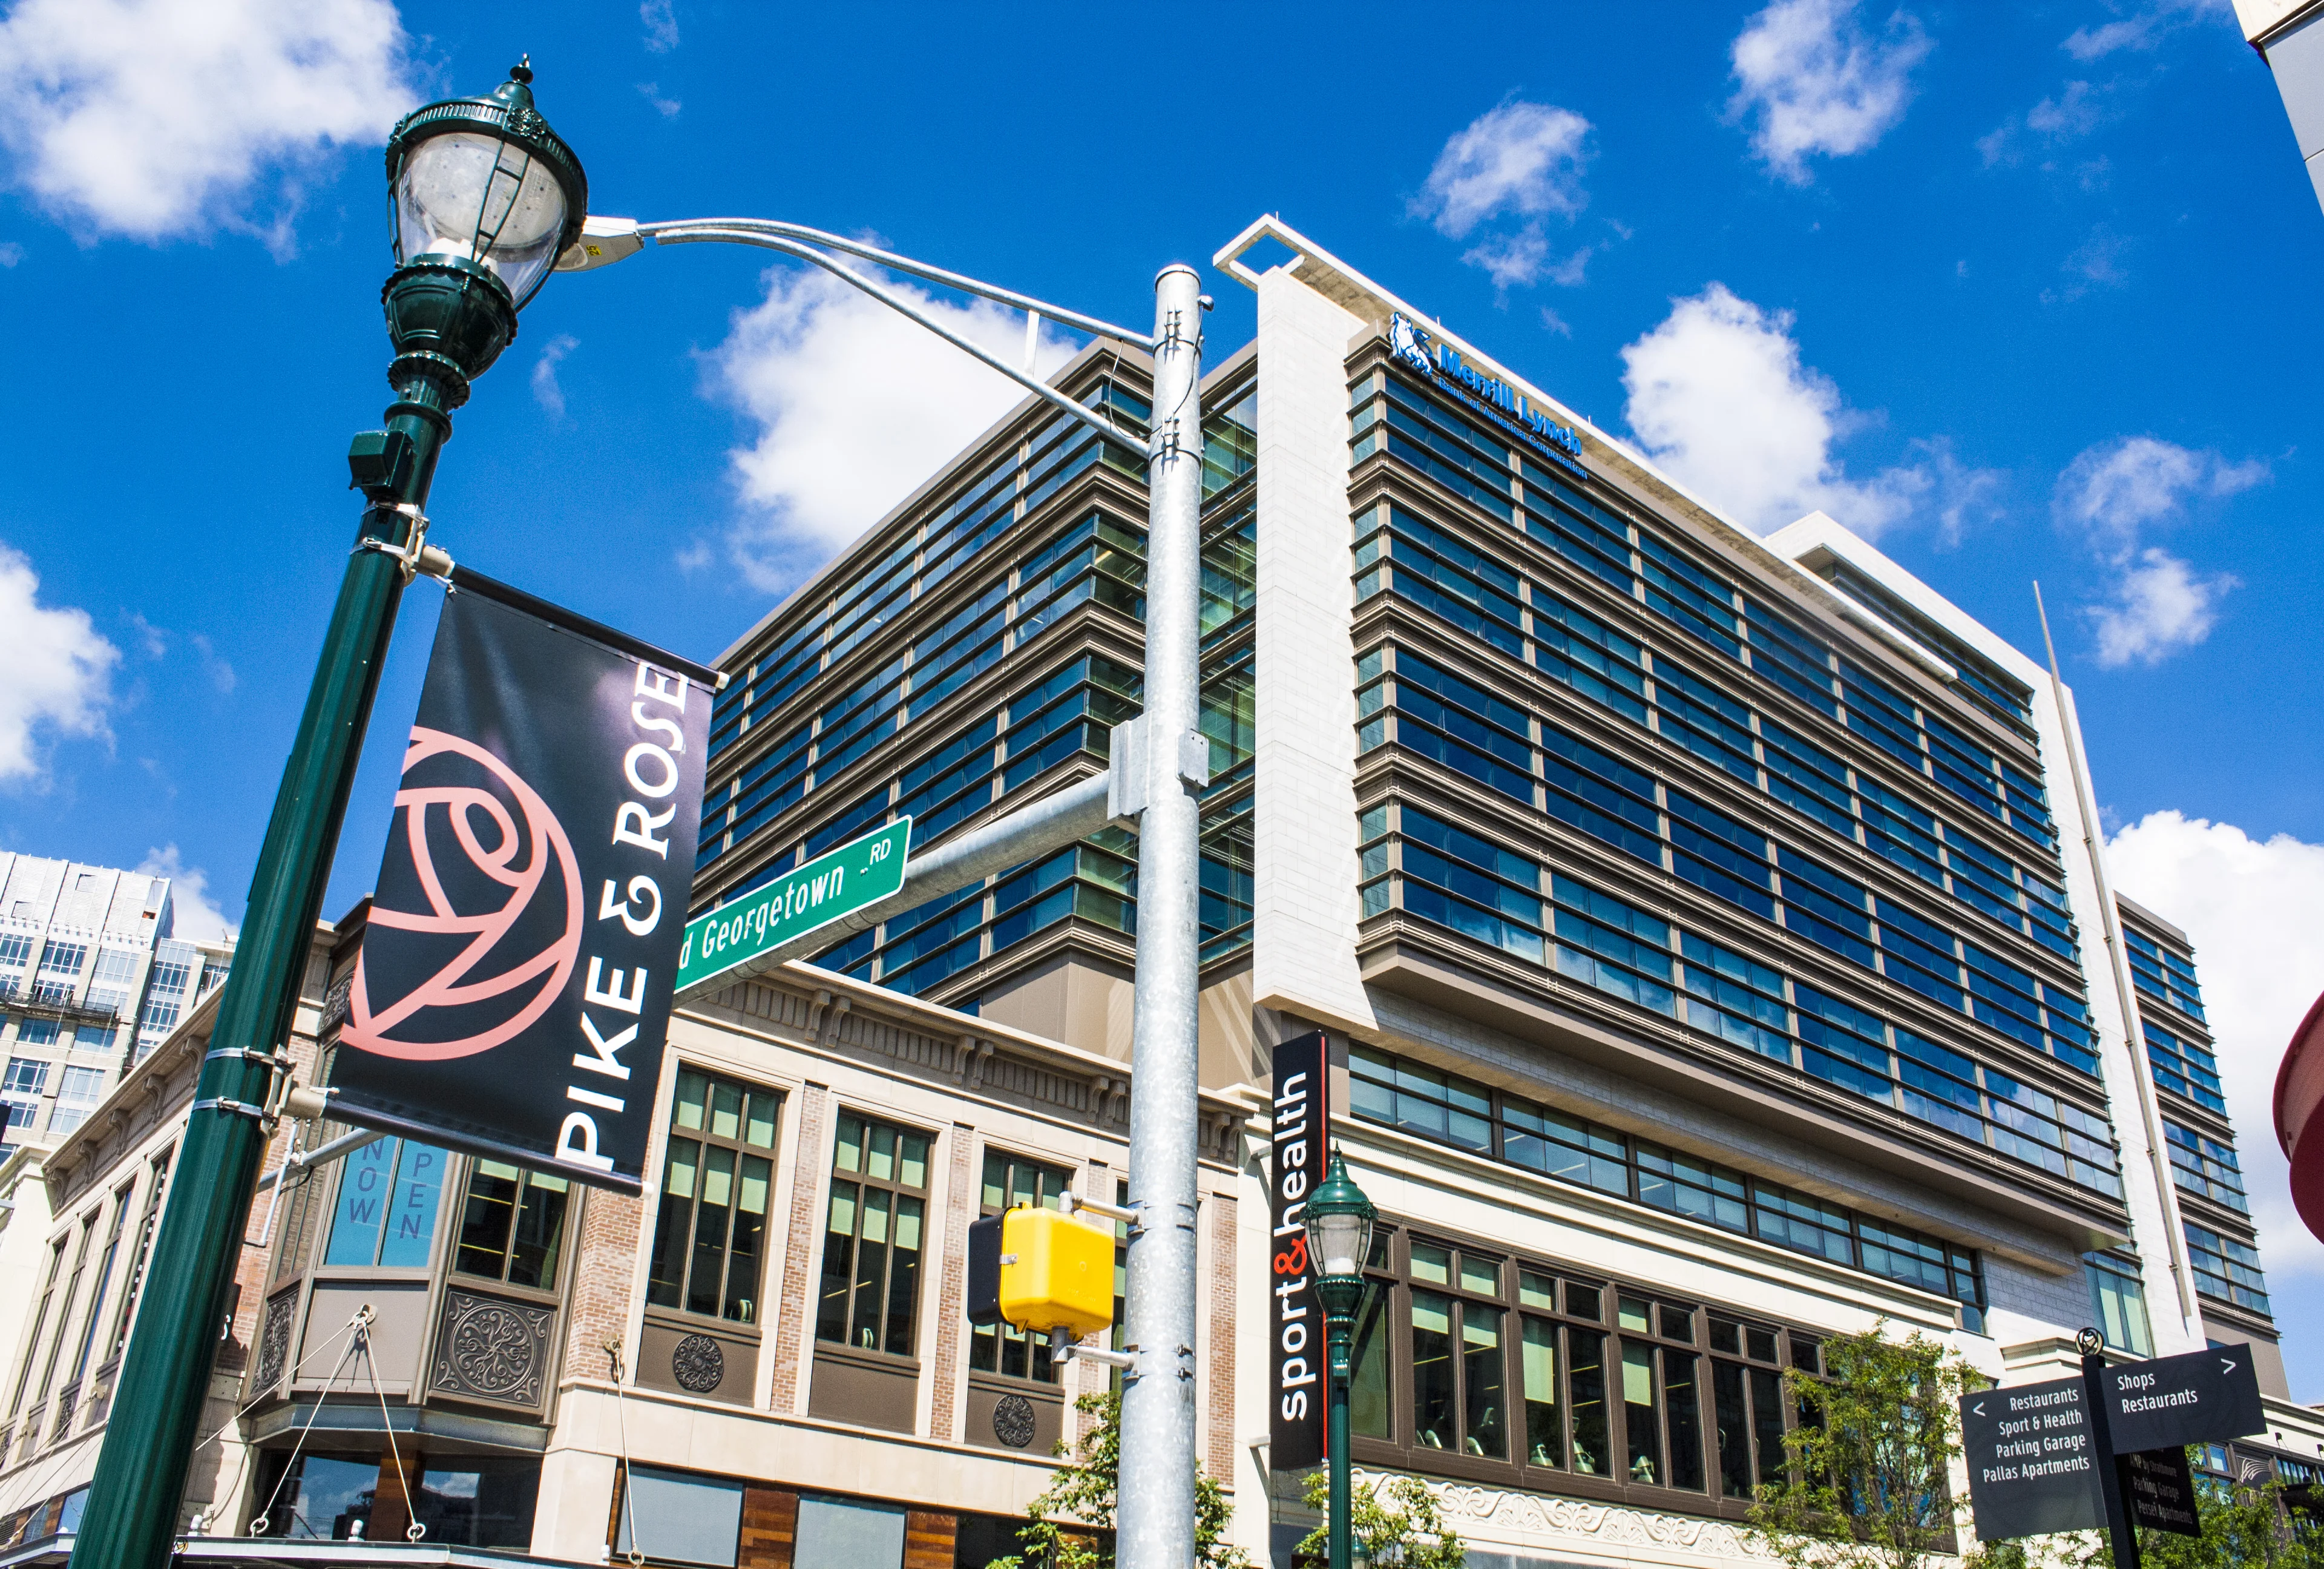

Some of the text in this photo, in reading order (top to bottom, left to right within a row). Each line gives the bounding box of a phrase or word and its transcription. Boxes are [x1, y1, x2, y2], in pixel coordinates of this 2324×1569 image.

[586, 245, 600, 255] 25
[1438, 343, 1582, 456] Merrill Lynch
[1439, 377, 1587, 481] Bank of America Corporation
[702, 866, 844, 959] Georgetown
[870, 838, 891, 865] RD
[555, 660, 688, 1171] PIKE & ROSE
[350, 1138, 384, 1223] NOW
[399, 1143, 433, 1239] PEN
[2118, 1373, 2155, 1390] Shops
[2010, 1388, 2079, 1411] Restaurants
[2122, 1389, 2198, 1413] Restaurants
[1999, 1409, 2083, 1438] Sport & Health
[1997, 1434, 2086, 1458] Parking Garage
[1983, 1456, 2090, 1482] Pallas Apartments
[2133, 1475, 2179, 1502] Parking Garage
[2138, 1499, 2193, 1524] Persei Apartments
